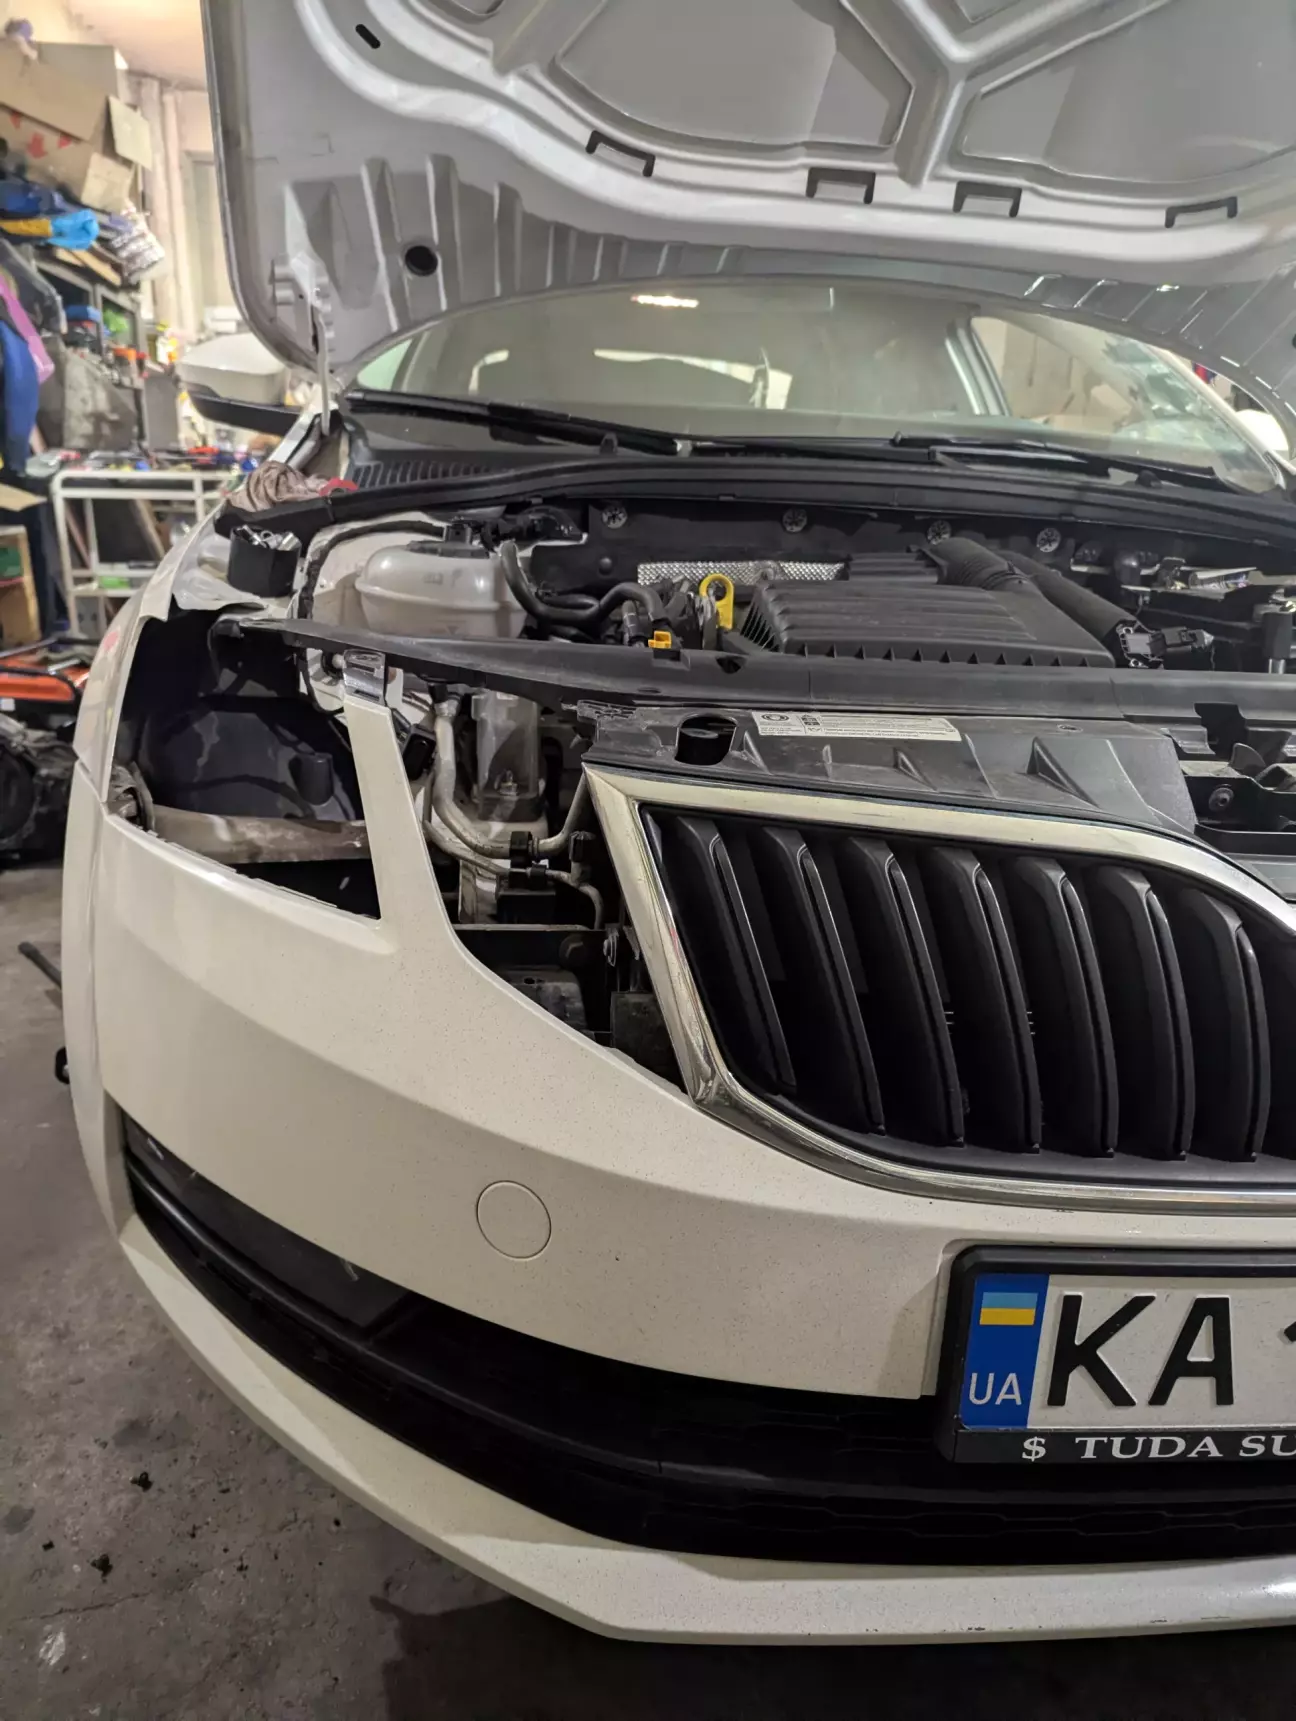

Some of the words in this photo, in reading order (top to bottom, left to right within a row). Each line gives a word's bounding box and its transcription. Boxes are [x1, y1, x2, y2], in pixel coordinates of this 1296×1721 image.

[1047, 1294, 1235, 1406] KA
[969, 1373, 1022, 1406] UA
[1022, 1436, 1046, 1461] $
[1075, 1436, 1223, 1459] TUDA
